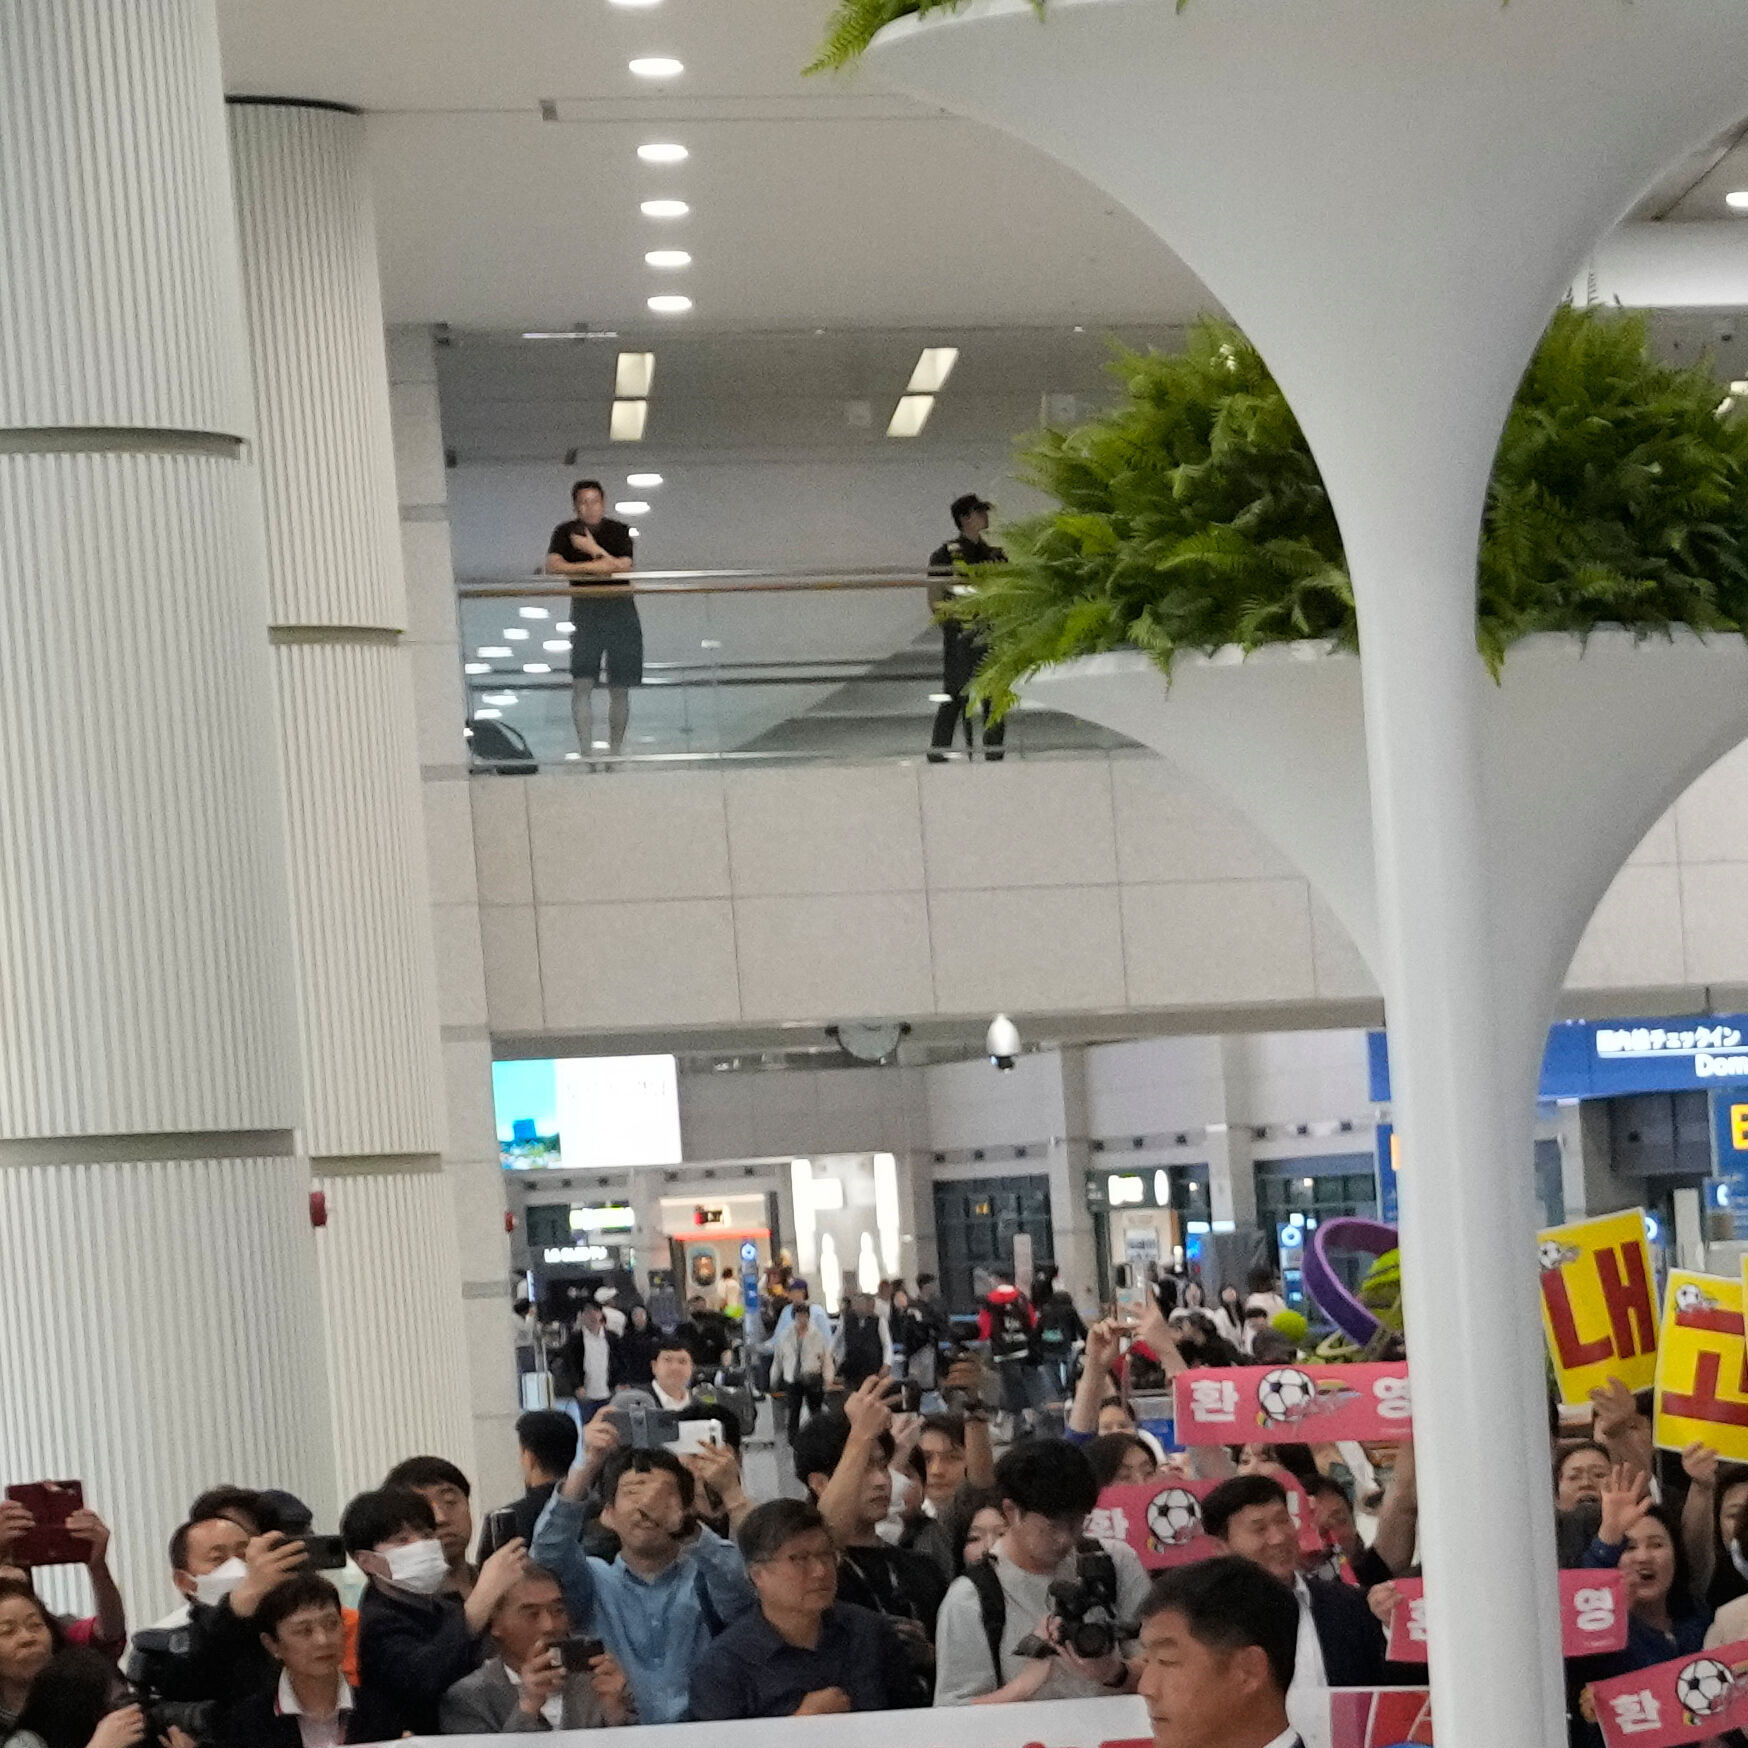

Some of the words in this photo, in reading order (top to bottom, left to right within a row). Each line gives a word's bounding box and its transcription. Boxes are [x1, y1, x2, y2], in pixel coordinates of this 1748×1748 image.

[1539, 1240, 1656, 1370] 내
[1190, 1380, 1239, 1422] 환
[1574, 1587, 1616, 1632] 영
[1609, 1689, 1662, 1735] 환
